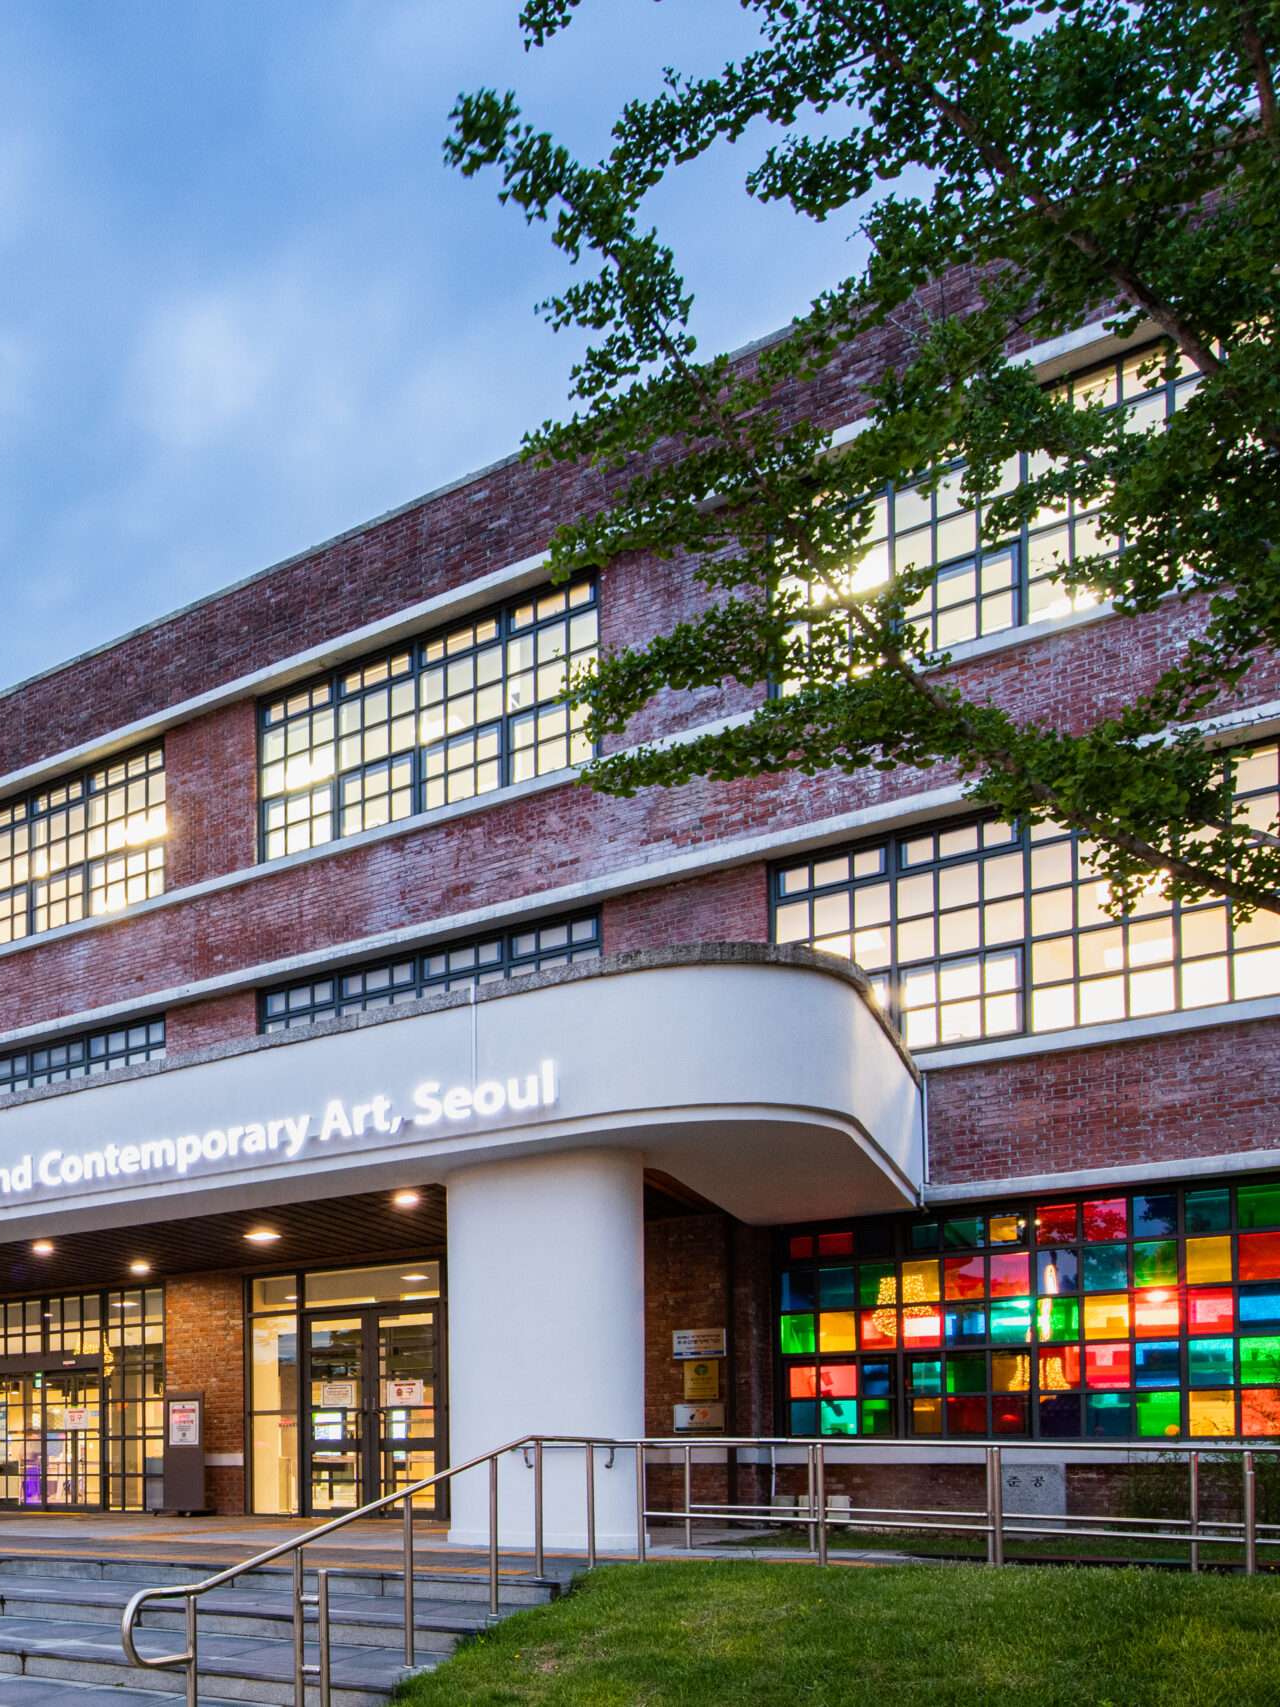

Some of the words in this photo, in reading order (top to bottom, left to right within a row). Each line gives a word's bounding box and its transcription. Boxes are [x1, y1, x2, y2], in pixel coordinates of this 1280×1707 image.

[38, 1114, 311, 1187] Contemporary
[319, 1095, 404, 1141] Art,
[413, 1059, 557, 1127] Seoul
